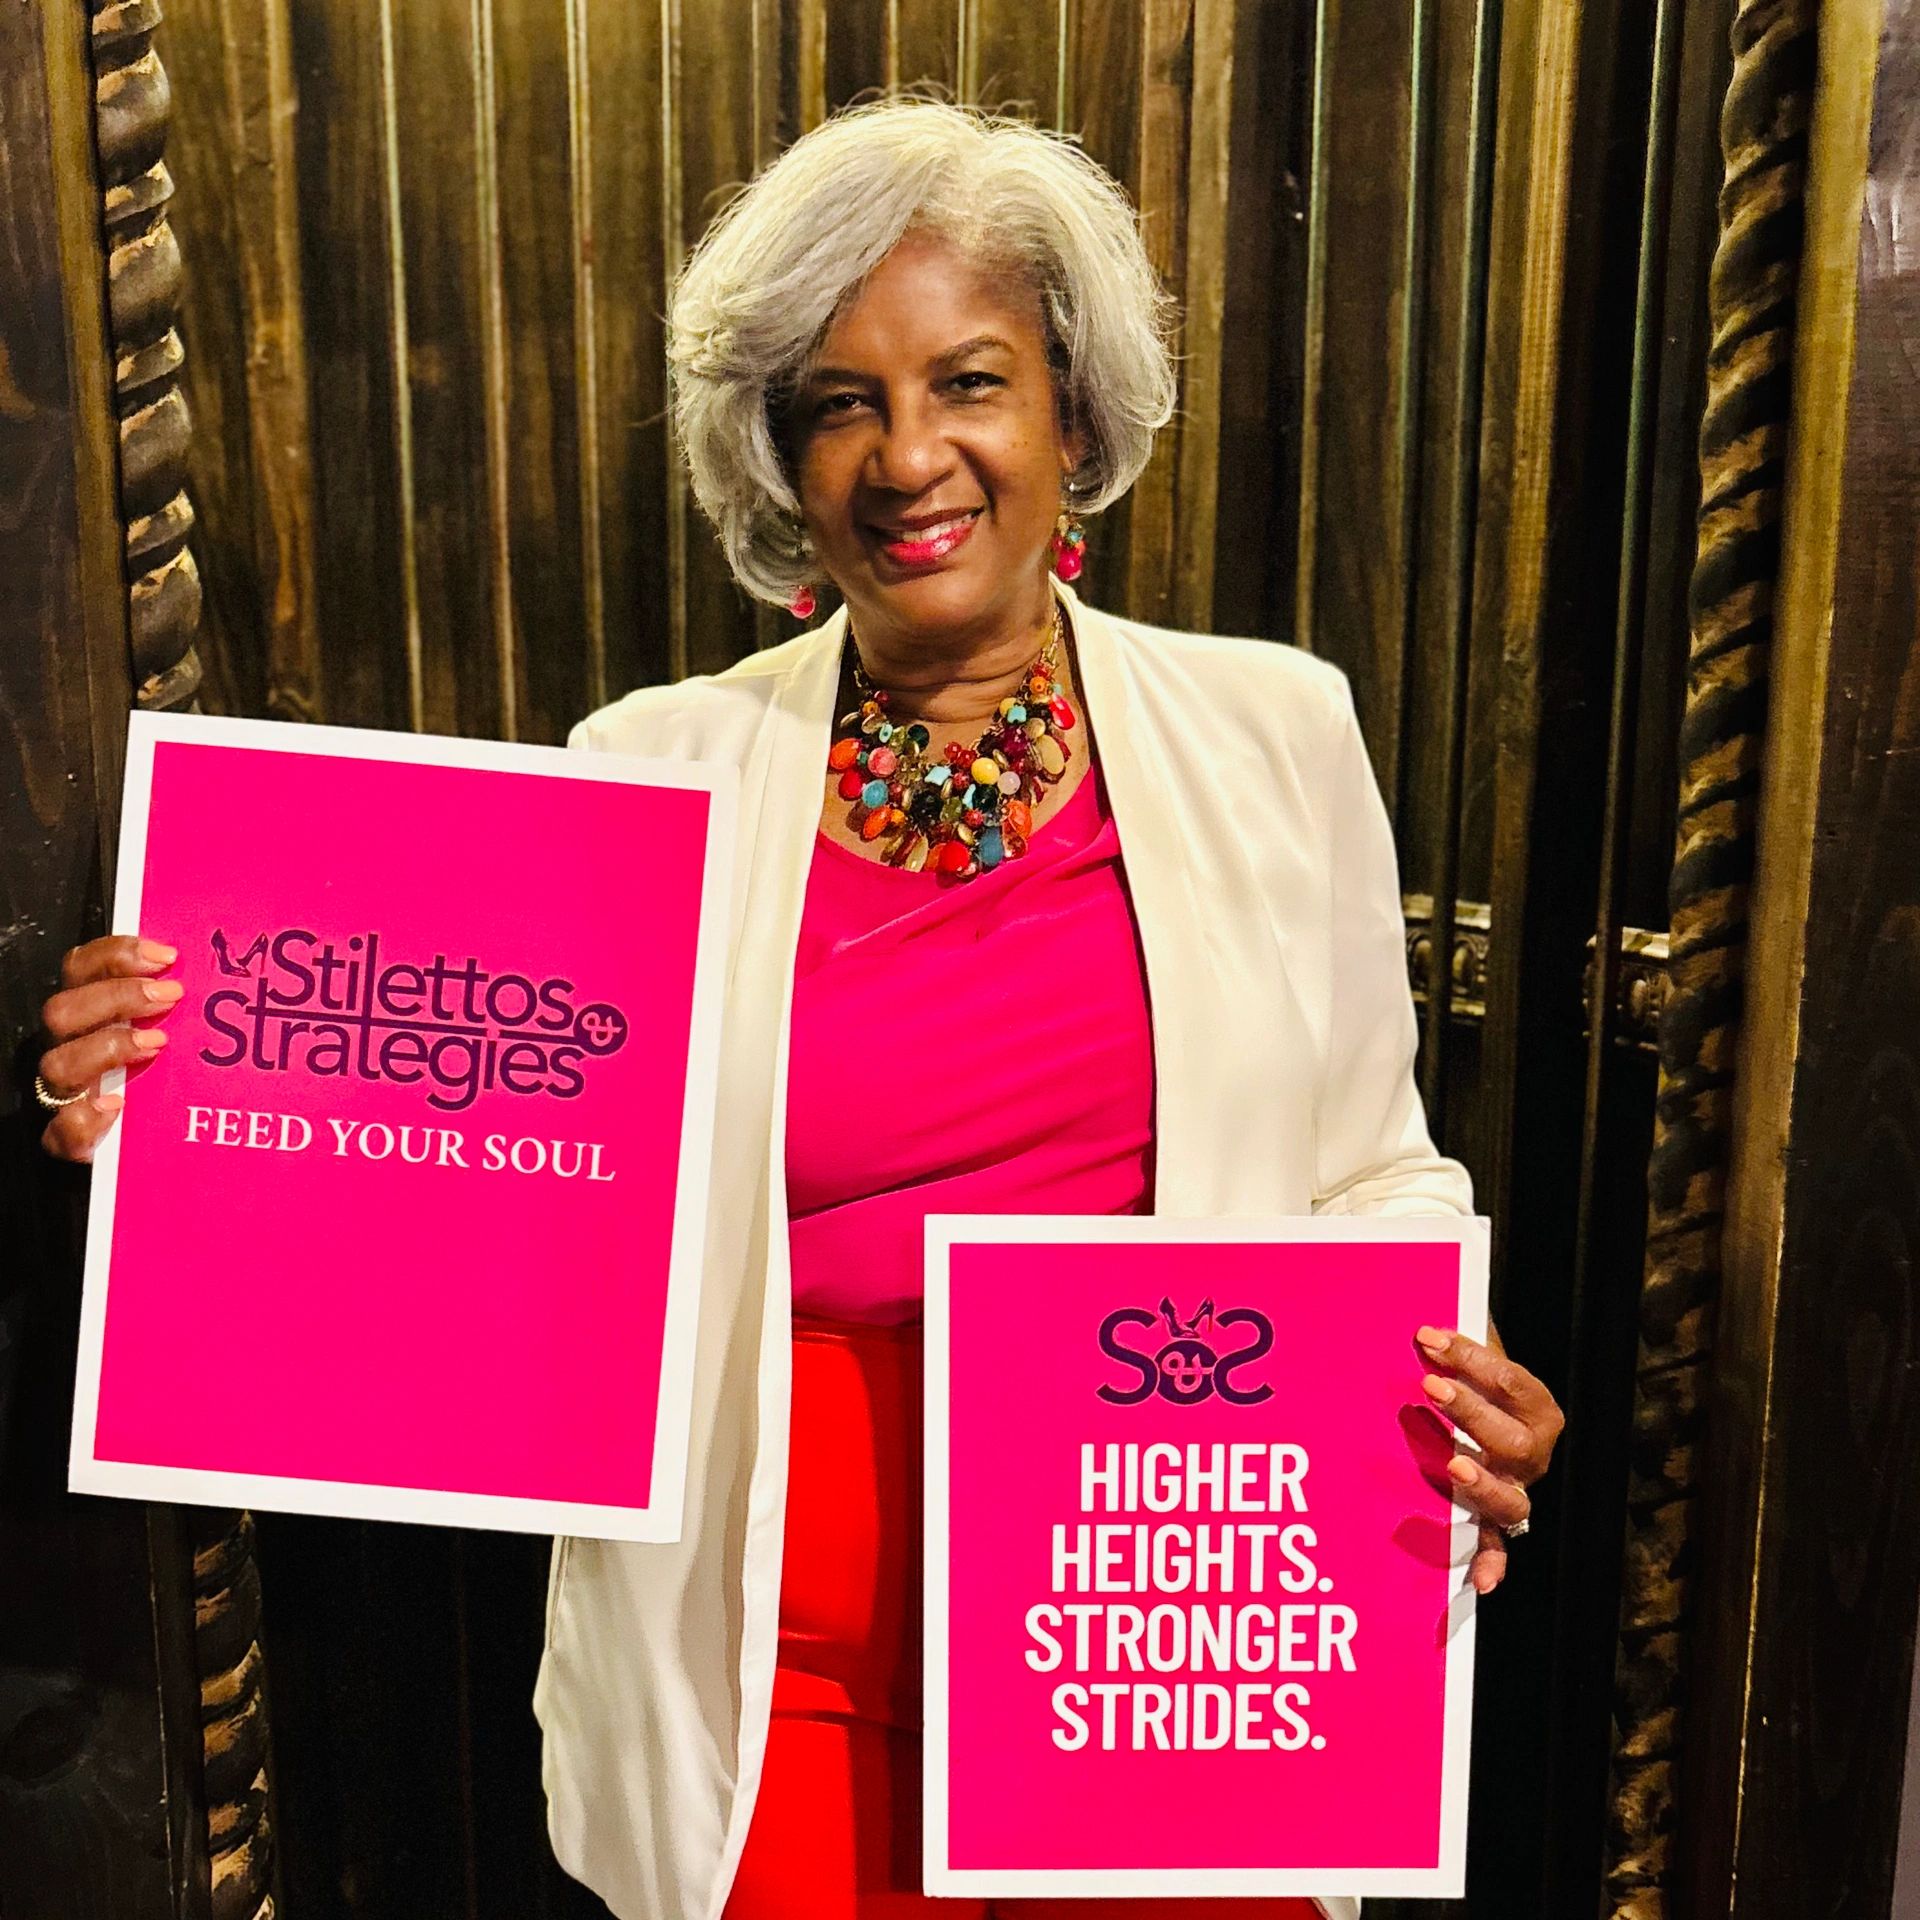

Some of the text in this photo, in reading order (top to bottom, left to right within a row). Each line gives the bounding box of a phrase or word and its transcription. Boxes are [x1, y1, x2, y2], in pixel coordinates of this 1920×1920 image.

[265, 928, 575, 1032] Stilettos
[199, 978, 585, 1112] Strategies
[184, 1106, 616, 1182] FEED YOUR SOUL
[1080, 1442, 1310, 1513] HIGHER
[1051, 1523, 1334, 1593] HEIGHTS.
[1024, 1603, 1358, 1673] STRONGER
[1051, 1682, 1327, 1752] STRIDES.
